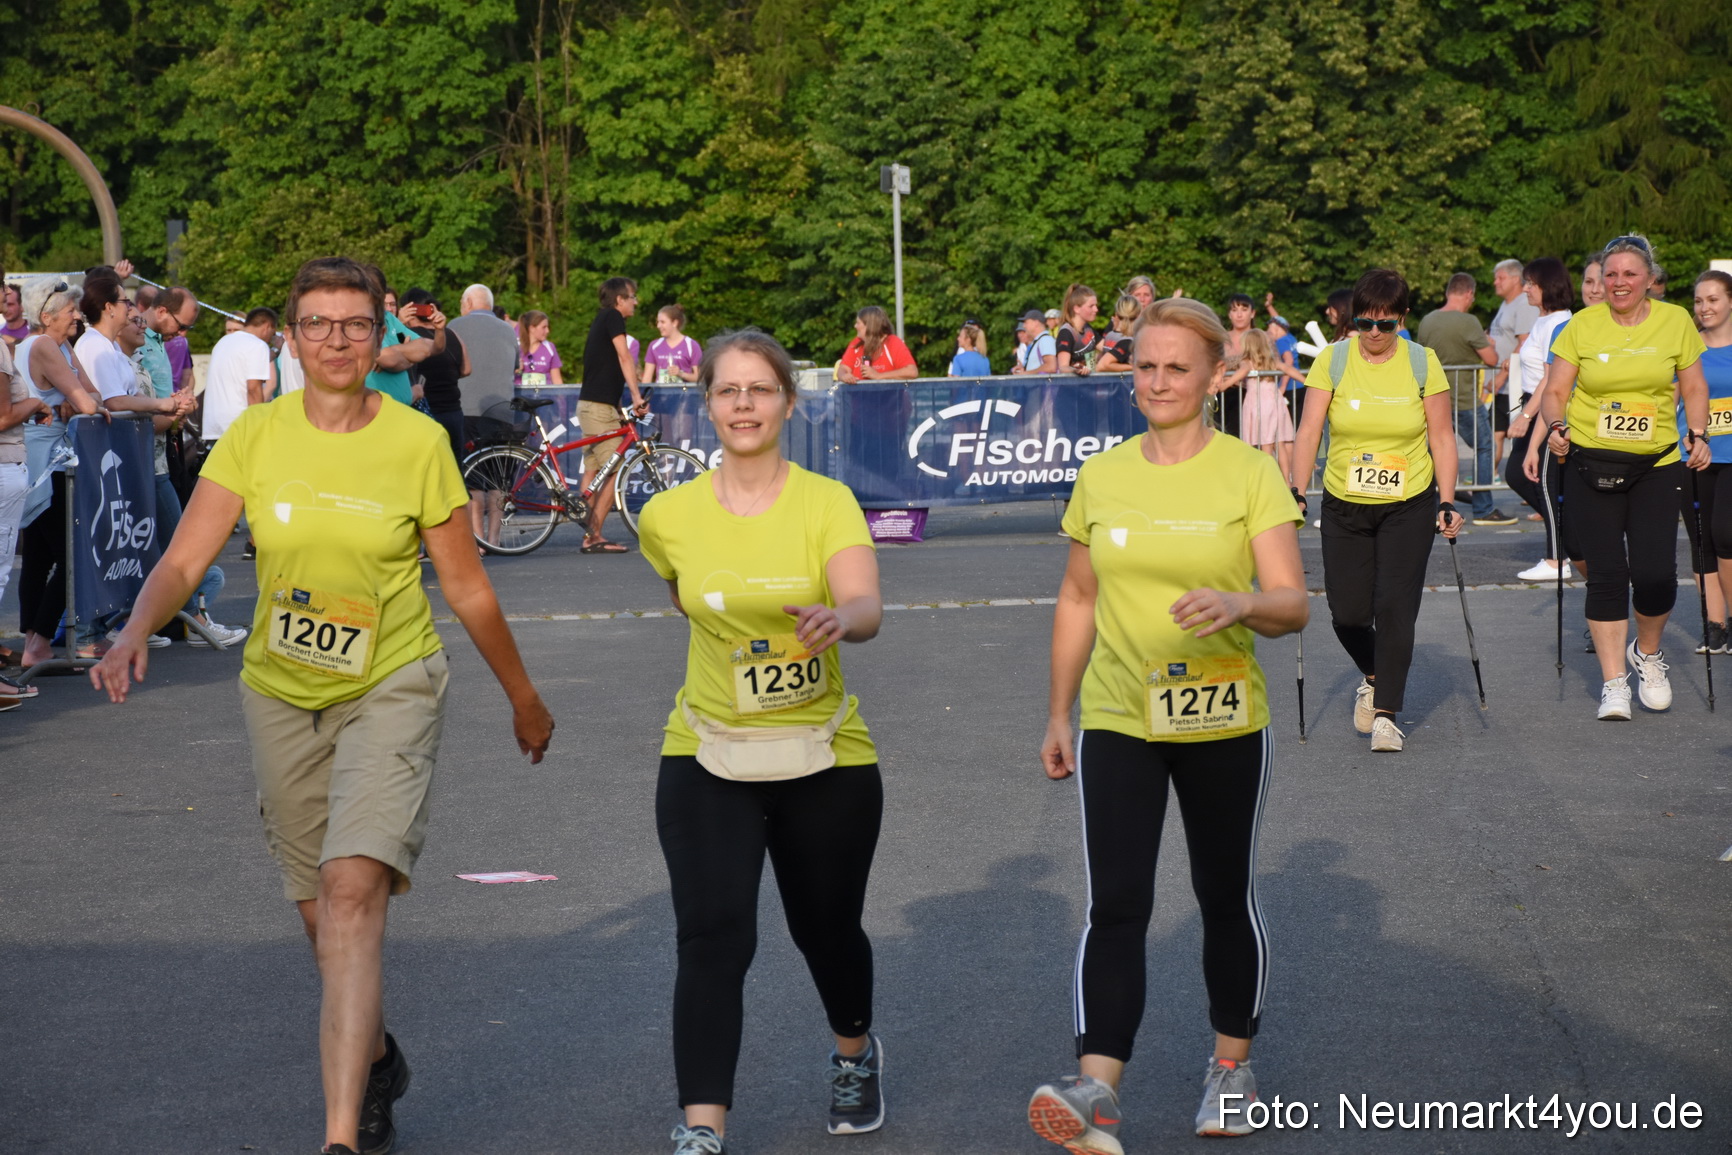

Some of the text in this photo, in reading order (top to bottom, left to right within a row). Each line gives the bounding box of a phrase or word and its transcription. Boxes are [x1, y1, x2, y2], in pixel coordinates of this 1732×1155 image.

[1604, 414, 1649, 432] 1226
[1708, 411, 1732, 426] 79
[949, 428, 1123, 466] Fischer
[965, 468, 1078, 487] AUTOMOB
[1355, 467, 1400, 487] 1264
[280, 597, 326, 615] firmenlauf
[279, 612, 361, 655] 1207
[278, 640, 352, 666] Borchert Christine
[286, 652, 338, 670] Klinikum Neumarkt
[744, 650, 787, 661] firmenlauf
[744, 657, 820, 695] 1230
[1160, 673, 1204, 684] firmenlauf
[758, 687, 815, 704] Grebner Tanja
[1159, 682, 1240, 717] 1274
[761, 702, 787, 710] Klinikum
[1169, 716, 1201, 726] Pietsch
[1202, 722, 1228, 730] Neumarkt
